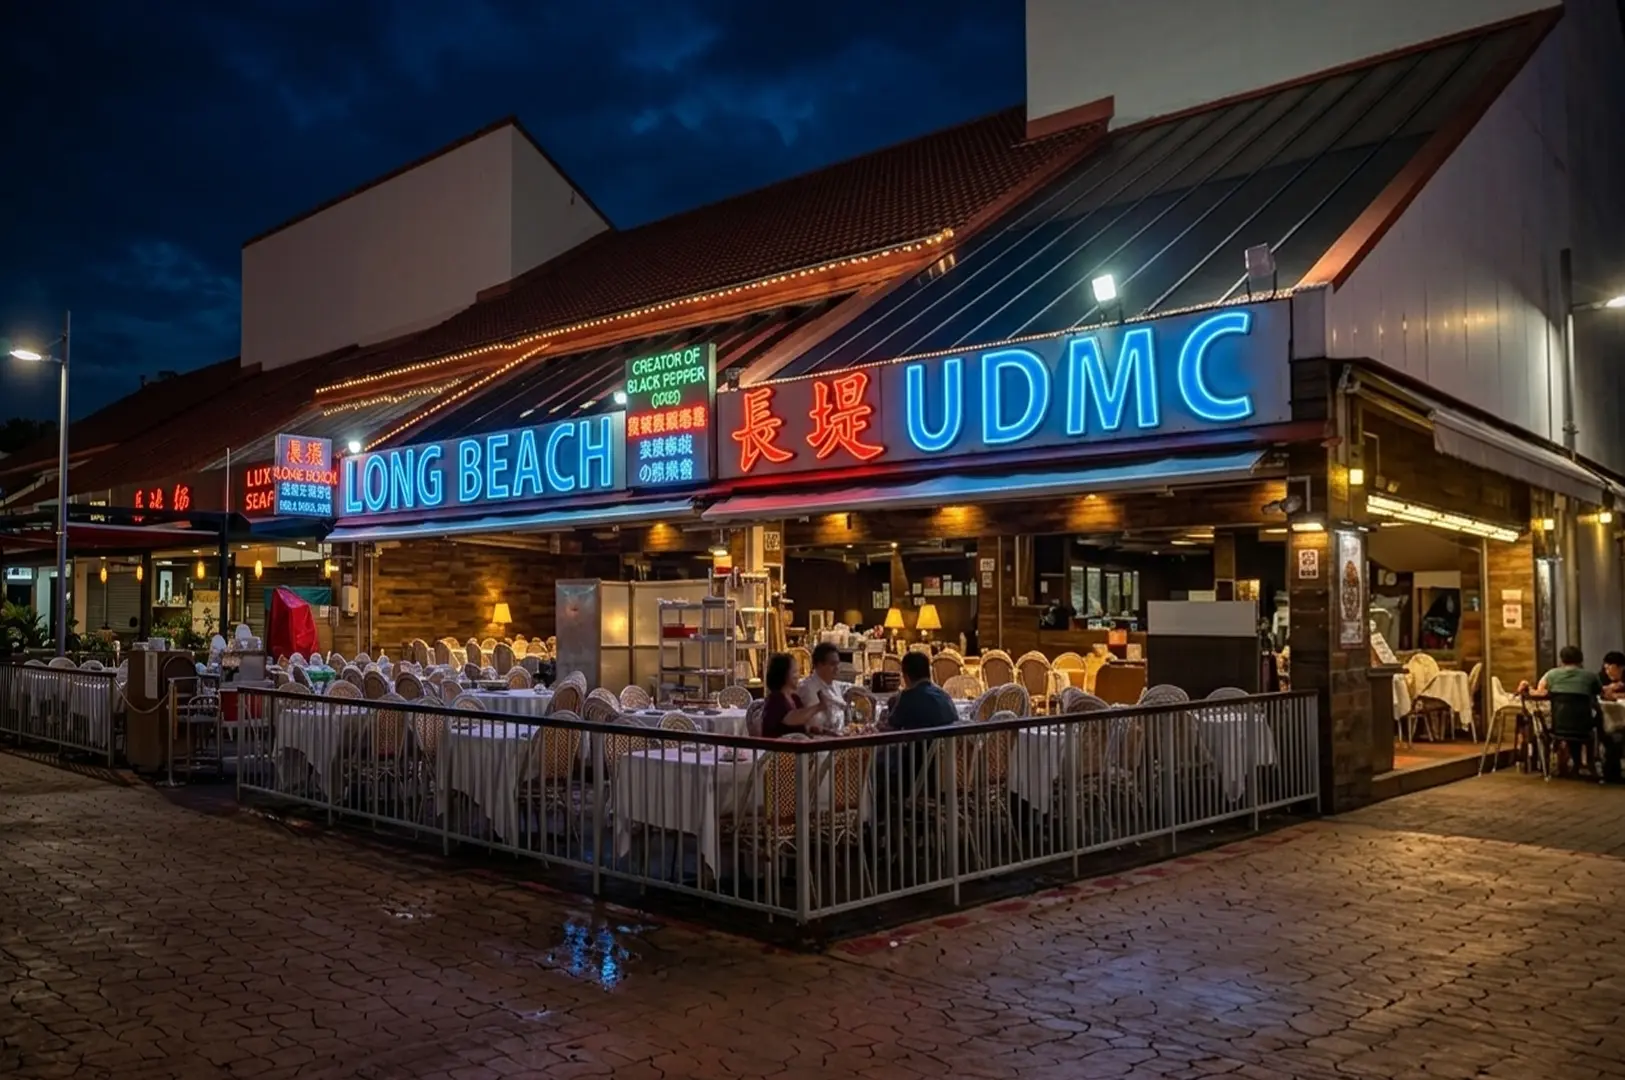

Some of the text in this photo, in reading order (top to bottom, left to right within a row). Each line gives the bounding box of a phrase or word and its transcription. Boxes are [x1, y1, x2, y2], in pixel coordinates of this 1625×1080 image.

[627, 366, 706, 394] BLACK PEPPER
[632, 347, 701, 375] CREATOR OF
[905, 310, 1254, 453] UDMC
[344, 415, 612, 514] LONG BEACH
[731, 372, 885, 473] 長堤
